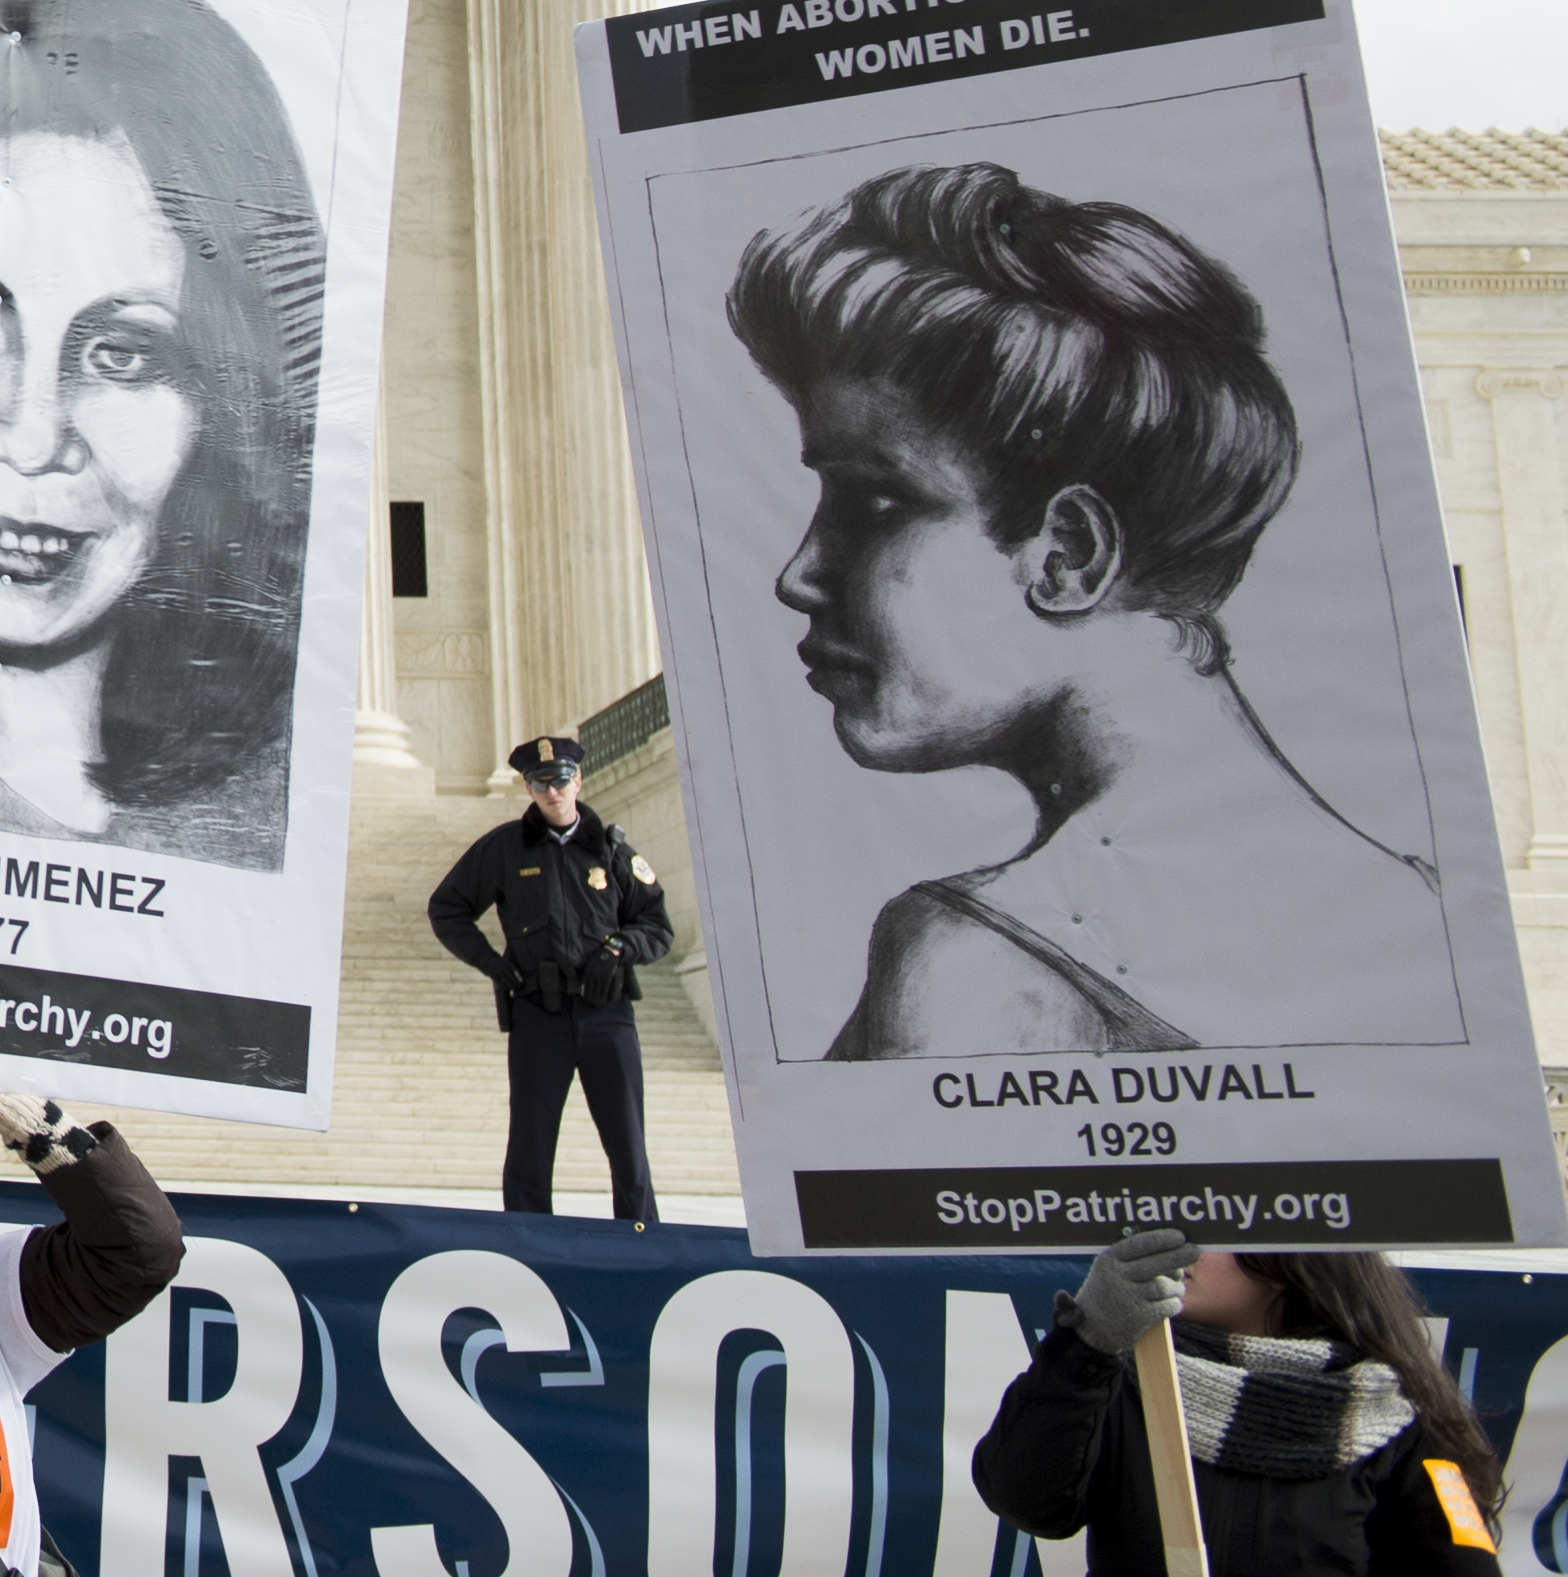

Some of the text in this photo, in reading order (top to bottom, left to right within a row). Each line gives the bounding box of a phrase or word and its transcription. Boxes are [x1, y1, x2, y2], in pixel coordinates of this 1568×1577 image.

[635, 9, 763, 58] WHEN
[814, 10, 1091, 81] WOMEN DIE.
[932, 1063, 1316, 1109] CLARA DUVALL
[1076, 1121, 1178, 1157] 1929
[935, 1186, 1351, 1233] StopPatriarchy.org
